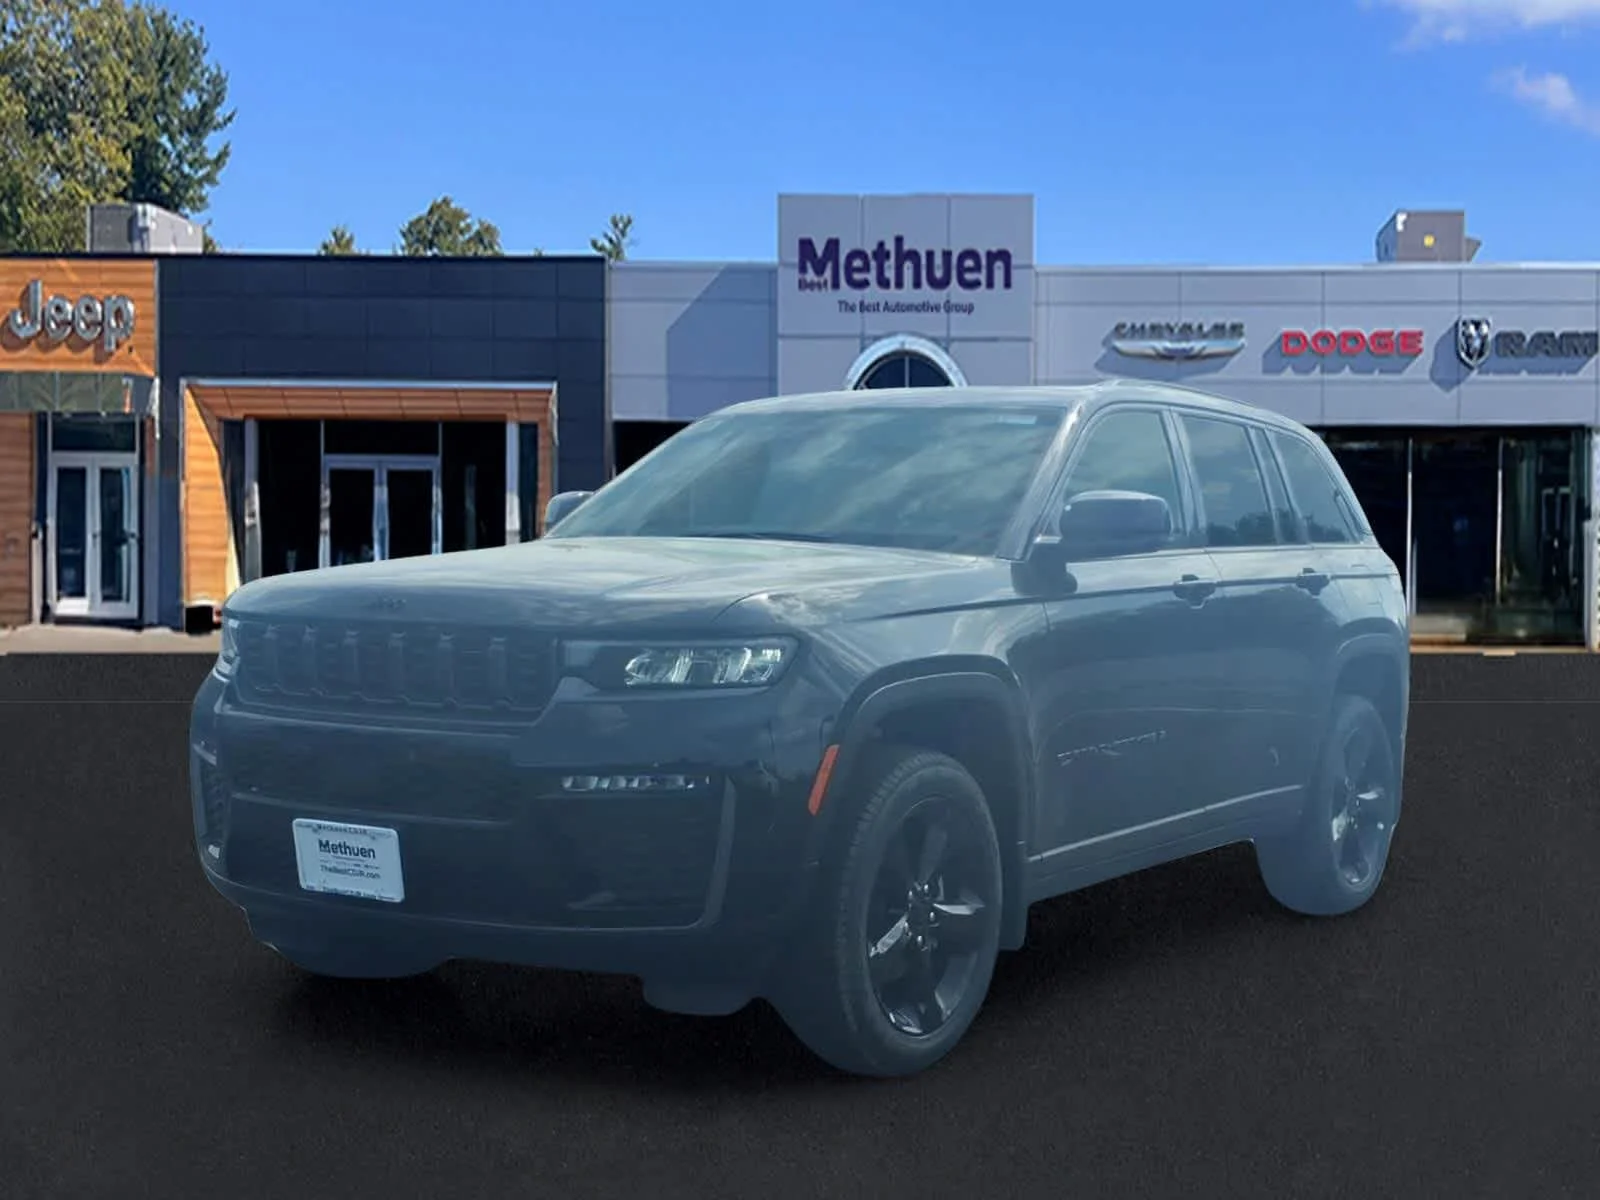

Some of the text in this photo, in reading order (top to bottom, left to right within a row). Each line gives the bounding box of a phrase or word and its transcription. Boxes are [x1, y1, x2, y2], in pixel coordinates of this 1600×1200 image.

[798, 235, 1012, 290] Methuen
[9, 279, 135, 351] Jeep
[837, 300, 974, 315] The Best Automotive Group
[1280, 328, 1424, 356] DODGE
[1495, 330, 1599, 358] RAM
[318, 838, 376, 860] Methuen
